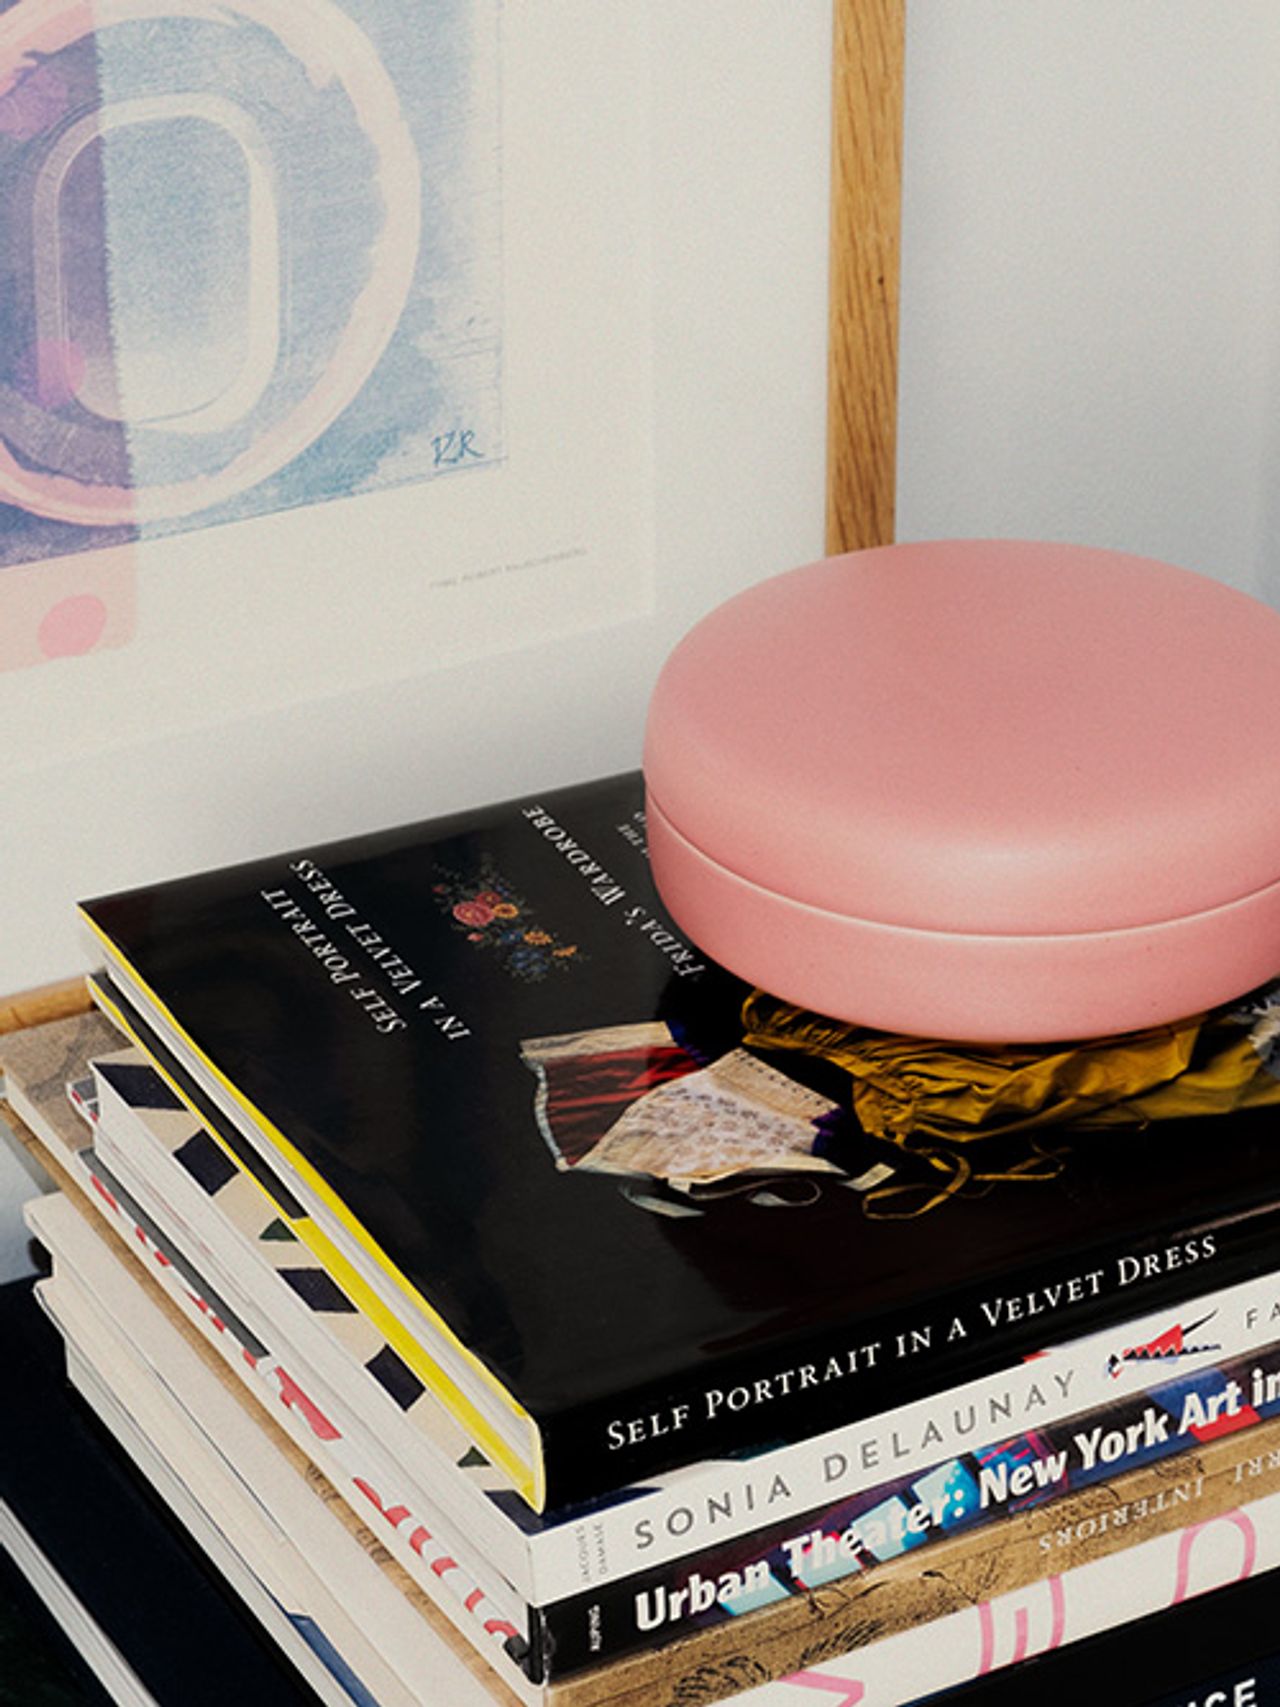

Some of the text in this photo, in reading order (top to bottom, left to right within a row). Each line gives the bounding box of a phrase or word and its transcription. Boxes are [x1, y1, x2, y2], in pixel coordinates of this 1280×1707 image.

[260, 889, 408, 1034] SELF PORTRAIT
[289, 858, 472, 1041] IN A VELVET DRESS
[522, 804, 706, 976] FRIDA'S WARDROBE
[606, 1234, 1218, 1450] SELF PORTRAIT IN A VELVET DRESS
[634, 1559, 771, 1632] Urban
[780, 1488, 965, 1579] Theater:
[978, 1449, 1067, 1509] New
[1073, 1408, 1171, 1471] York
[1176, 1379, 1242, 1436] Art
[635, 1369, 1075, 1550] SONIA DELAUNAY
[1038, 1476, 1206, 1553] INTERIORS
